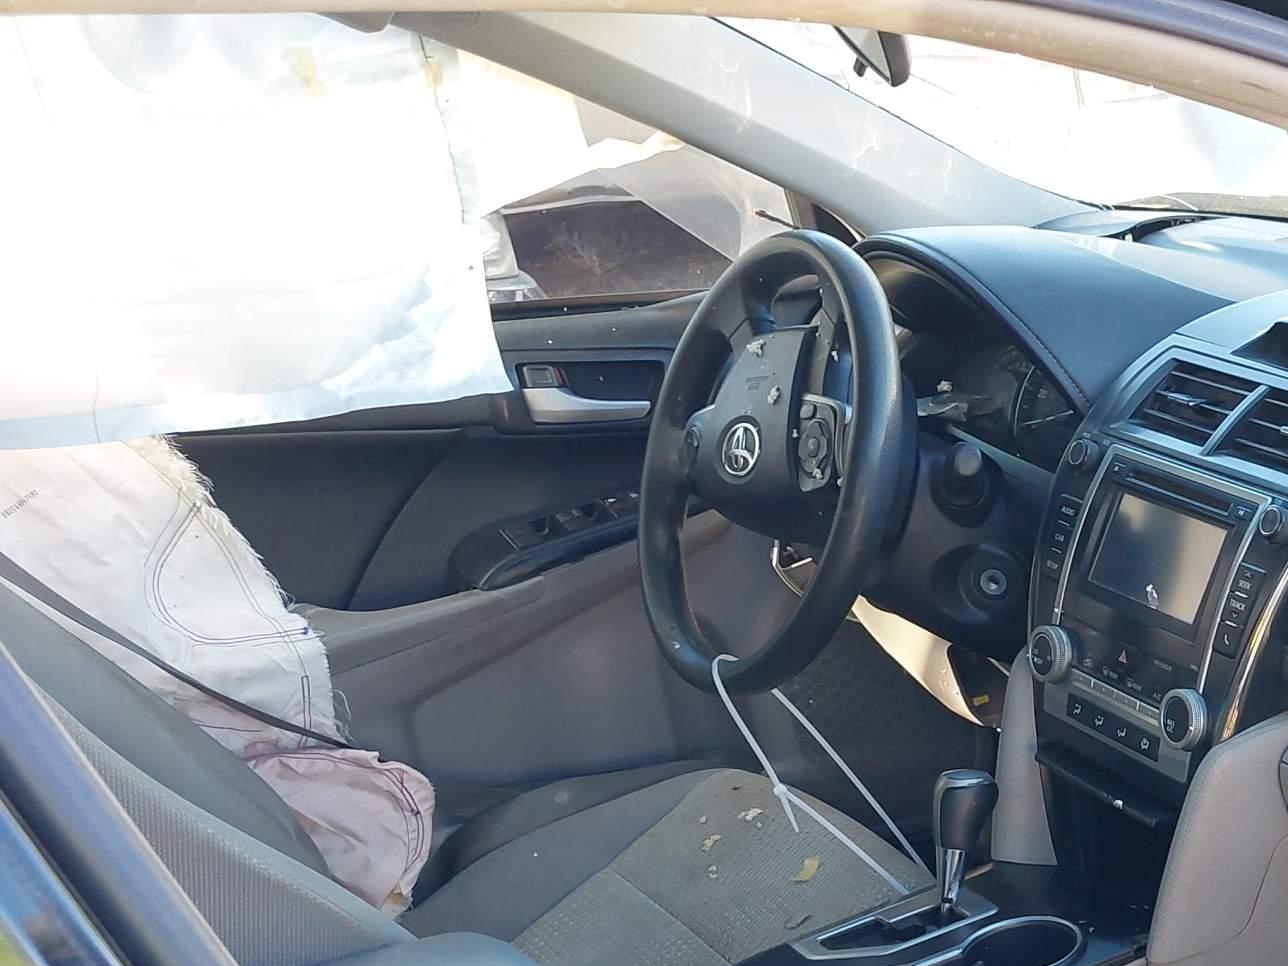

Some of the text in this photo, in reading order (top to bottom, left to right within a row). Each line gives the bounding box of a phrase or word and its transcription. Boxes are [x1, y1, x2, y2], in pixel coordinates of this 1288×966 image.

[1061, 505, 1076, 517] AUDIO
[1237, 579, 1253, 590] SEEK
[1229, 598, 1246, 611] TRACK
